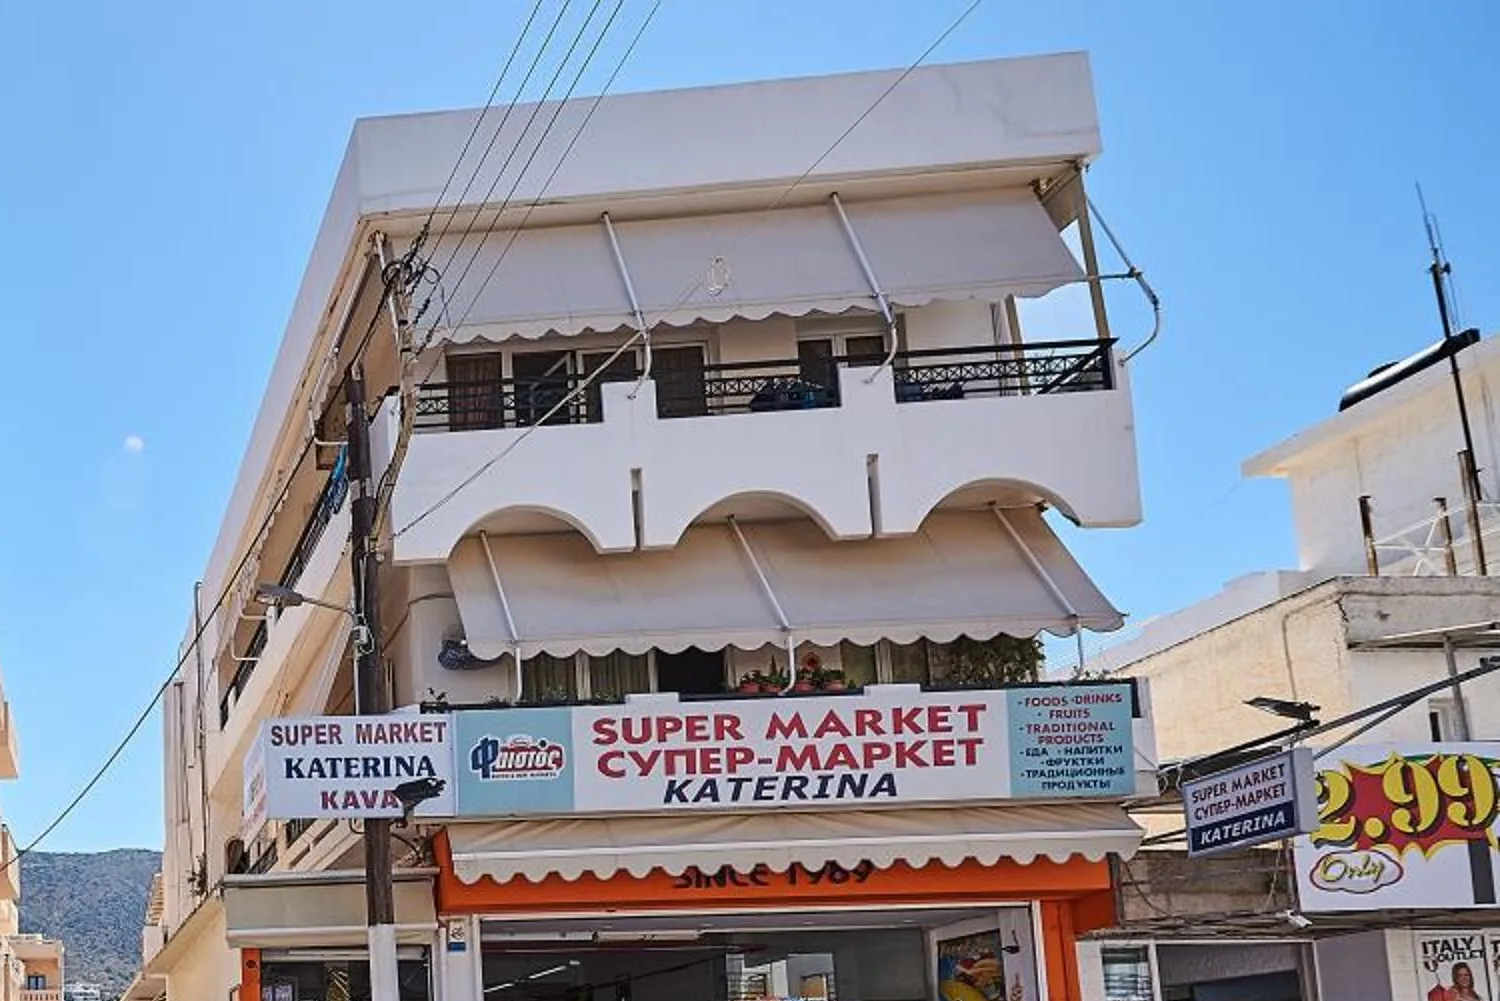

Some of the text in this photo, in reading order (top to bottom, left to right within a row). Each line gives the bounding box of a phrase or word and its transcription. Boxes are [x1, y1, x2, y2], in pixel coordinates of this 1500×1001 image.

[1025, 693, 1123, 707] FOODS DRINKS
[592, 703, 987, 745] SUPER MARKET
[1049, 708, 1091, 719] FRUITS
[271, 721, 447, 746] SUPER MARKET
[1025, 721, 1116, 734] TRADITIONAL
[1038, 734, 1104, 745] PRODUCTS
[285, 755, 437, 779] KATERINA
[597, 737, 984, 778] СУПЕР-МАРКЕТ
[663, 772, 898, 804] KATERINA
[1191, 763, 1285, 803] SUPER MARKET
[320, 789, 399, 811] KAVA
[1194, 782, 1286, 821] СУПЕР-МАРКЕТ
[1200, 810, 1286, 845] KATERINA
[1421, 935, 1475, 955] ITALY
